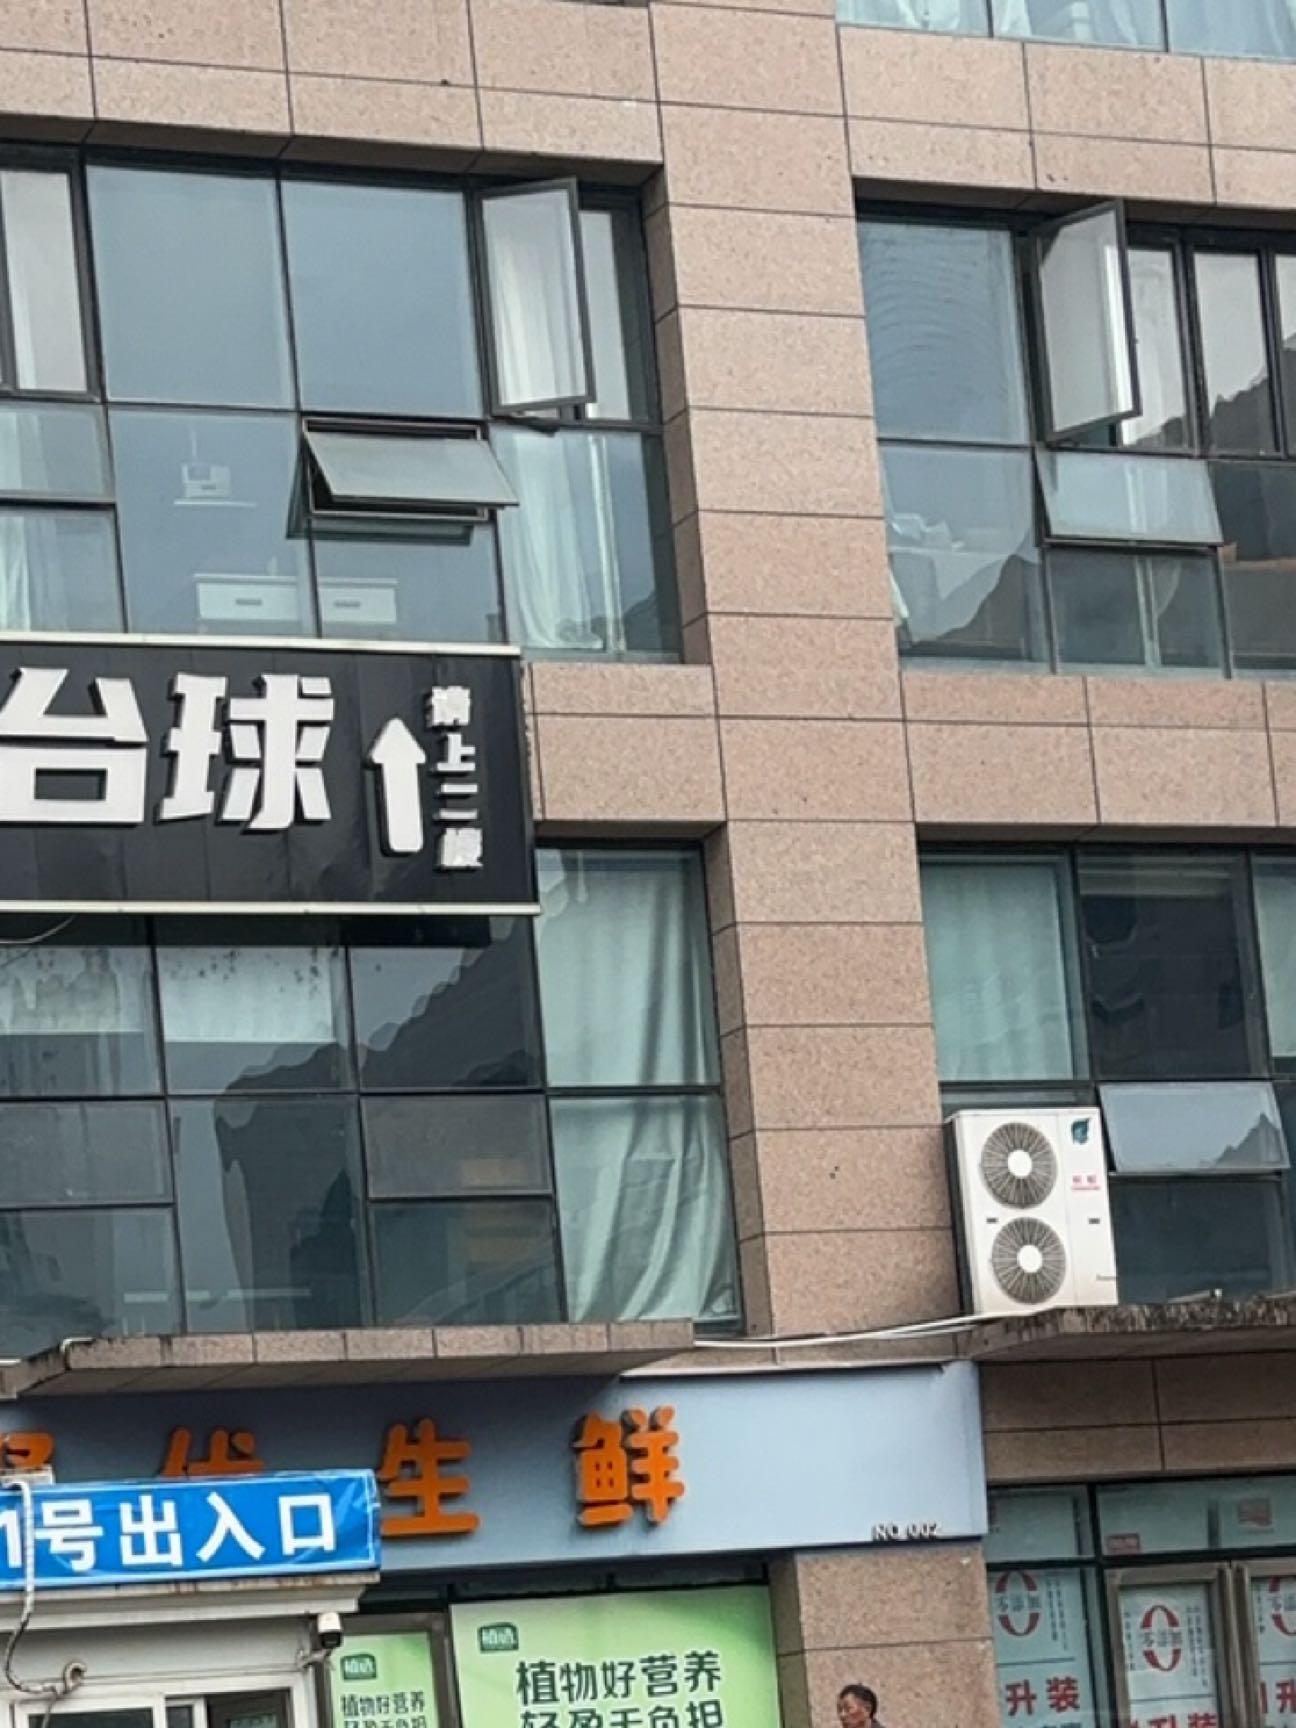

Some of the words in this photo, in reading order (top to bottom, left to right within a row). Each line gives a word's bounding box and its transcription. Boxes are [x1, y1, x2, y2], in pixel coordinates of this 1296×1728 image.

[516, 1651, 722, 1706] 植物好营养
